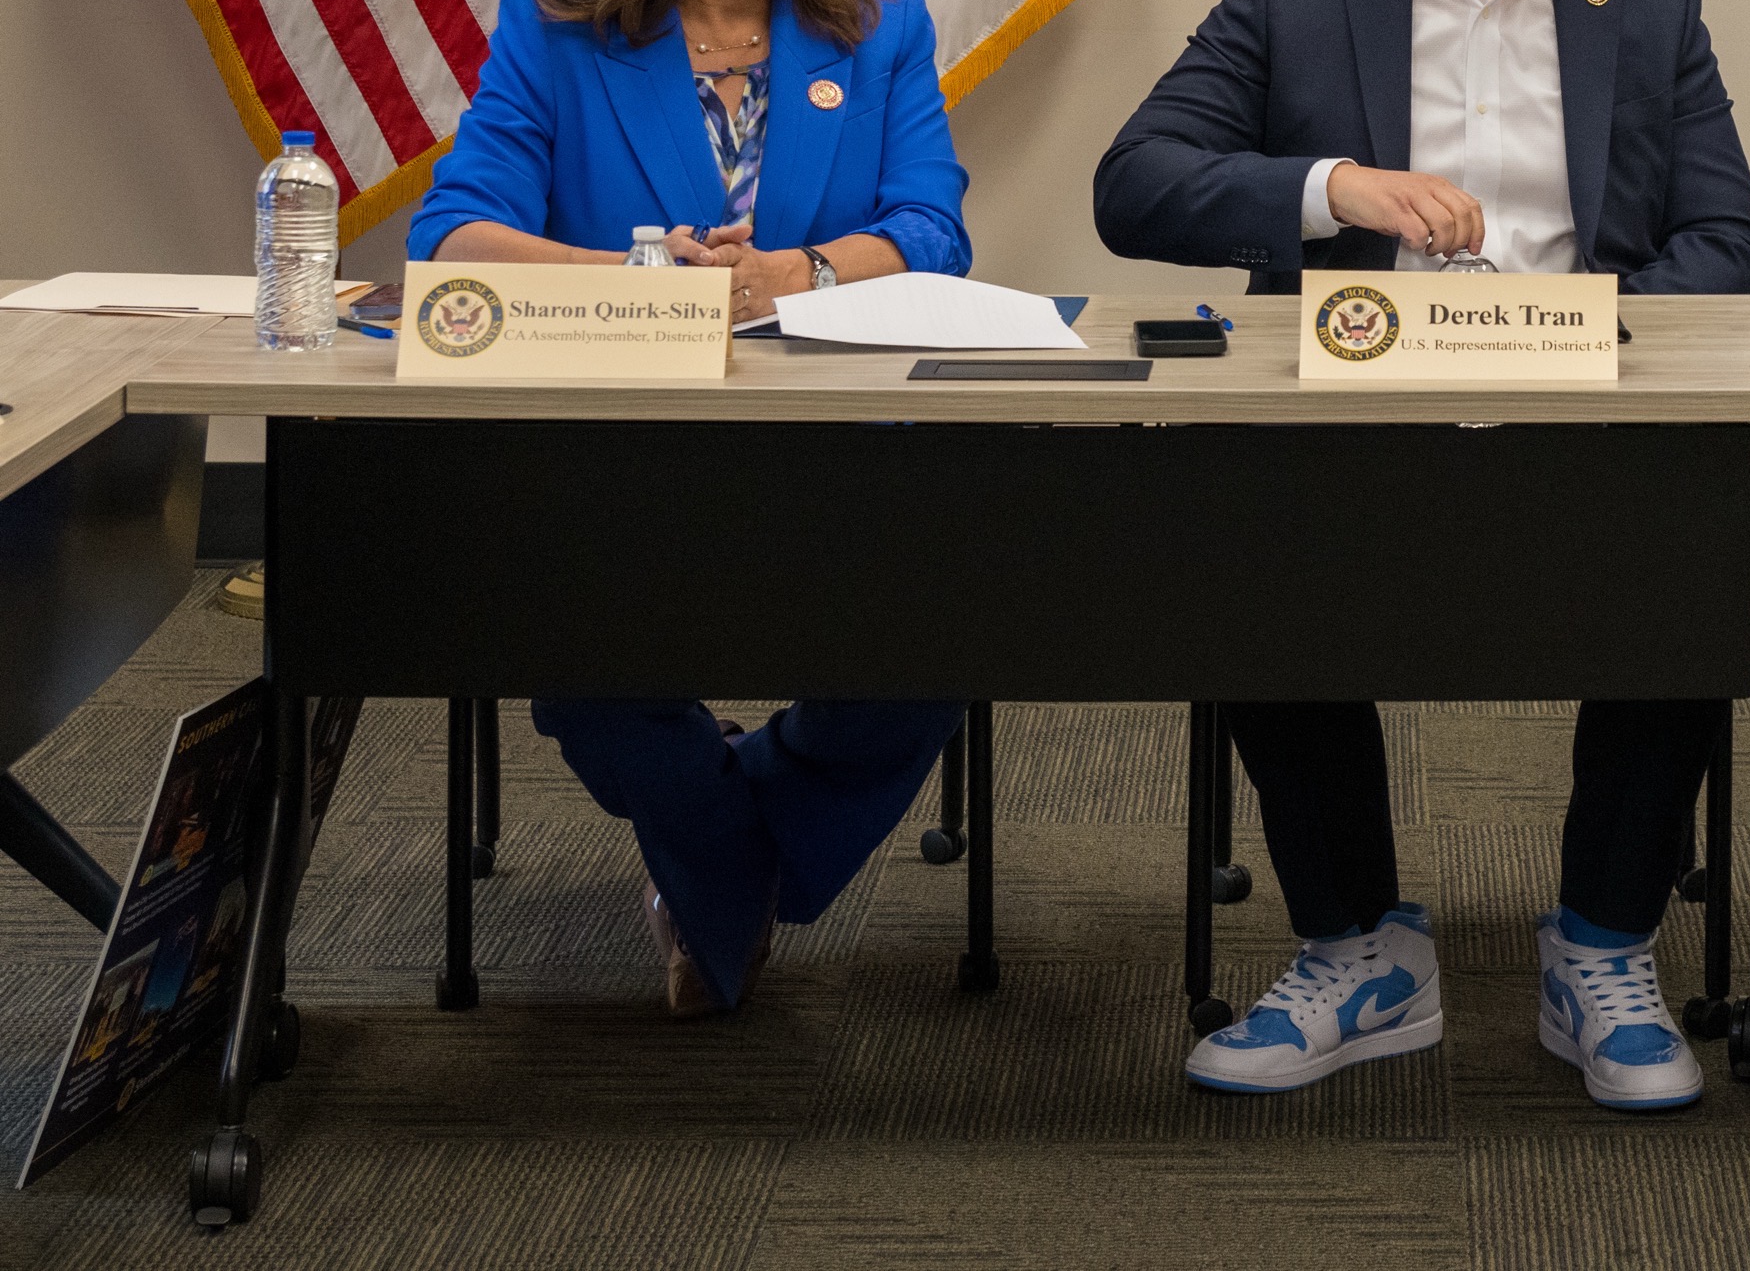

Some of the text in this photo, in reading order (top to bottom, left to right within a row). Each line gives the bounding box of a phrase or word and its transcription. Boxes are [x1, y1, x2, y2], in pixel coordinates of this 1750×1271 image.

[447, 280, 488, 296] HOUSE
[487, 293, 500, 307] OF
[1323, 288, 1396, 314] U.S. HOUSE OF
[509, 300, 722, 322] Sharon Quirk-Silva
[1427, 303, 1585, 327] Derek Tran
[503, 329, 724, 345] CA Assemblymember, District 67
[1318, 326, 1398, 360] REPRESENTATIVES
[1401, 339, 1611, 354] U.S. Representative, District 45
